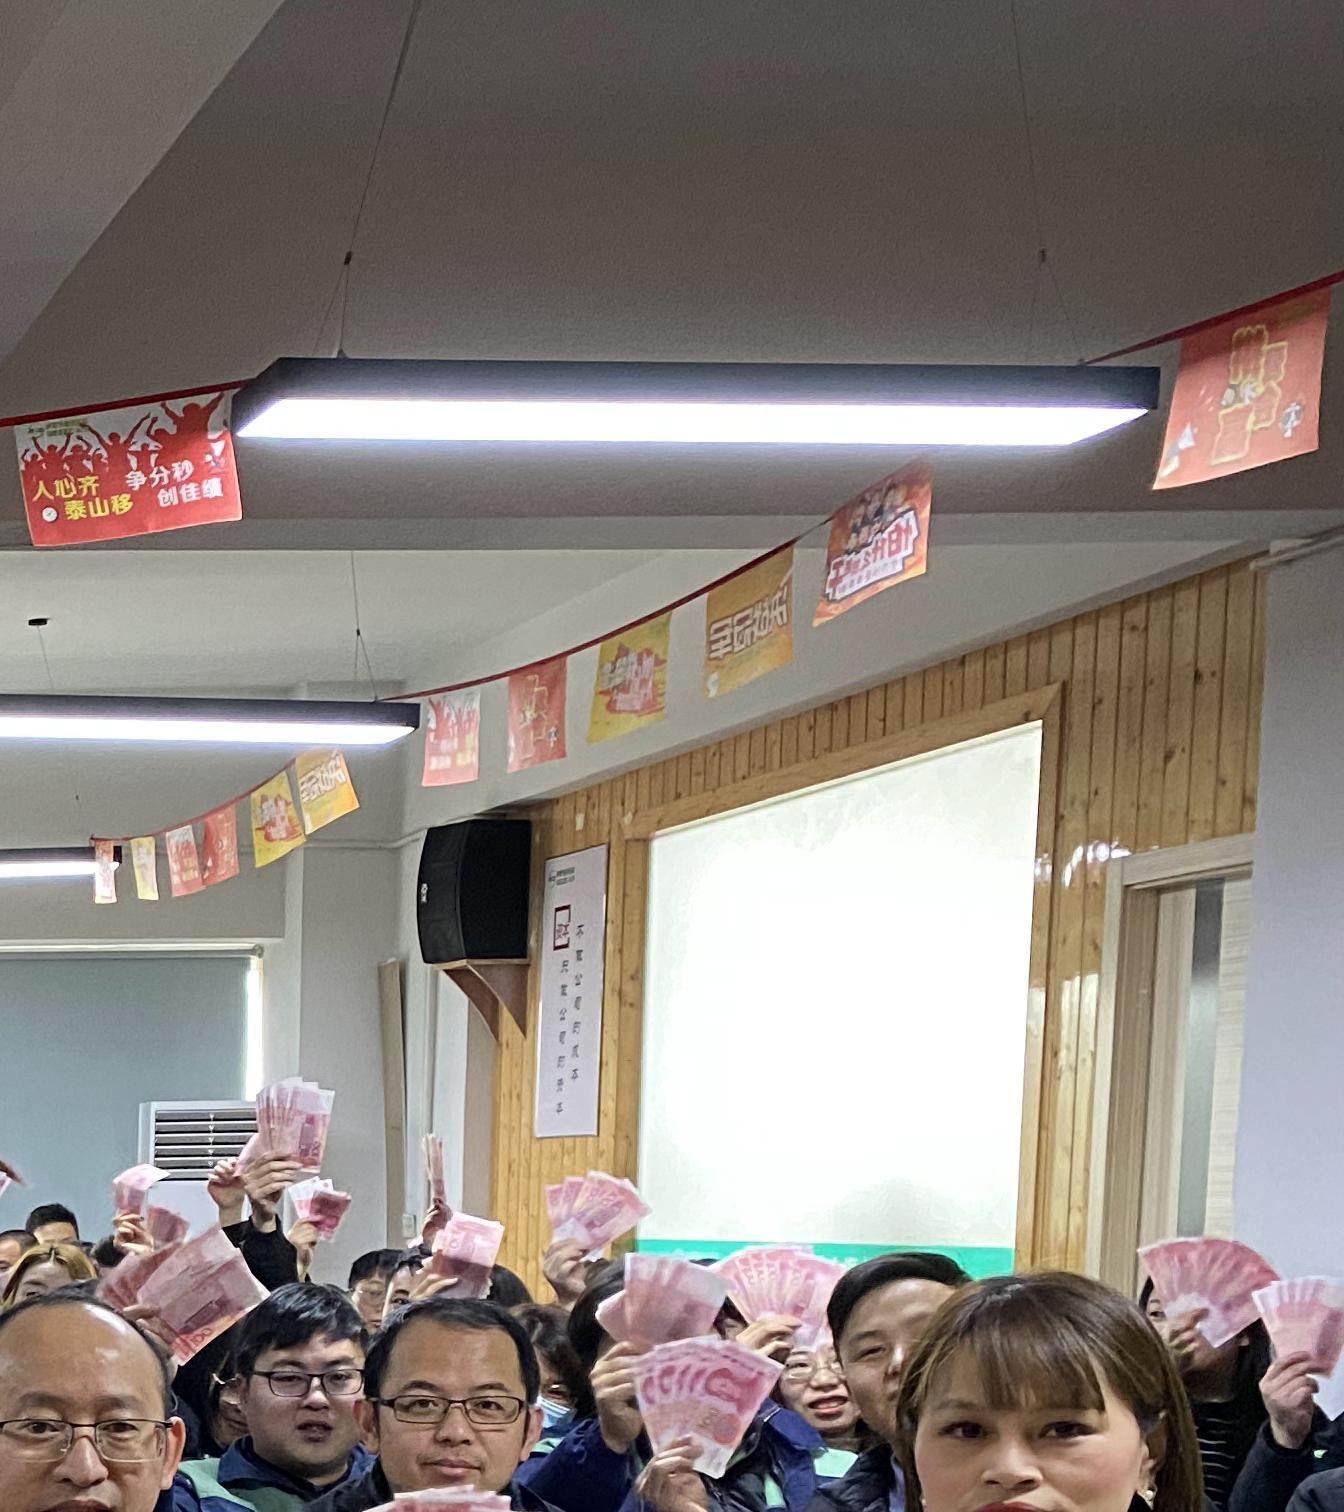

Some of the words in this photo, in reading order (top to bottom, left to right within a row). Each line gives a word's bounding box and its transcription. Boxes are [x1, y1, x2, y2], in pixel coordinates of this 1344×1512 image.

[32, 476, 100, 501] 人心齐
[125, 459, 195, 491] 争分秒
[157, 477, 224, 507] 创佳绩
[64, 493, 134, 520] 泰山移
